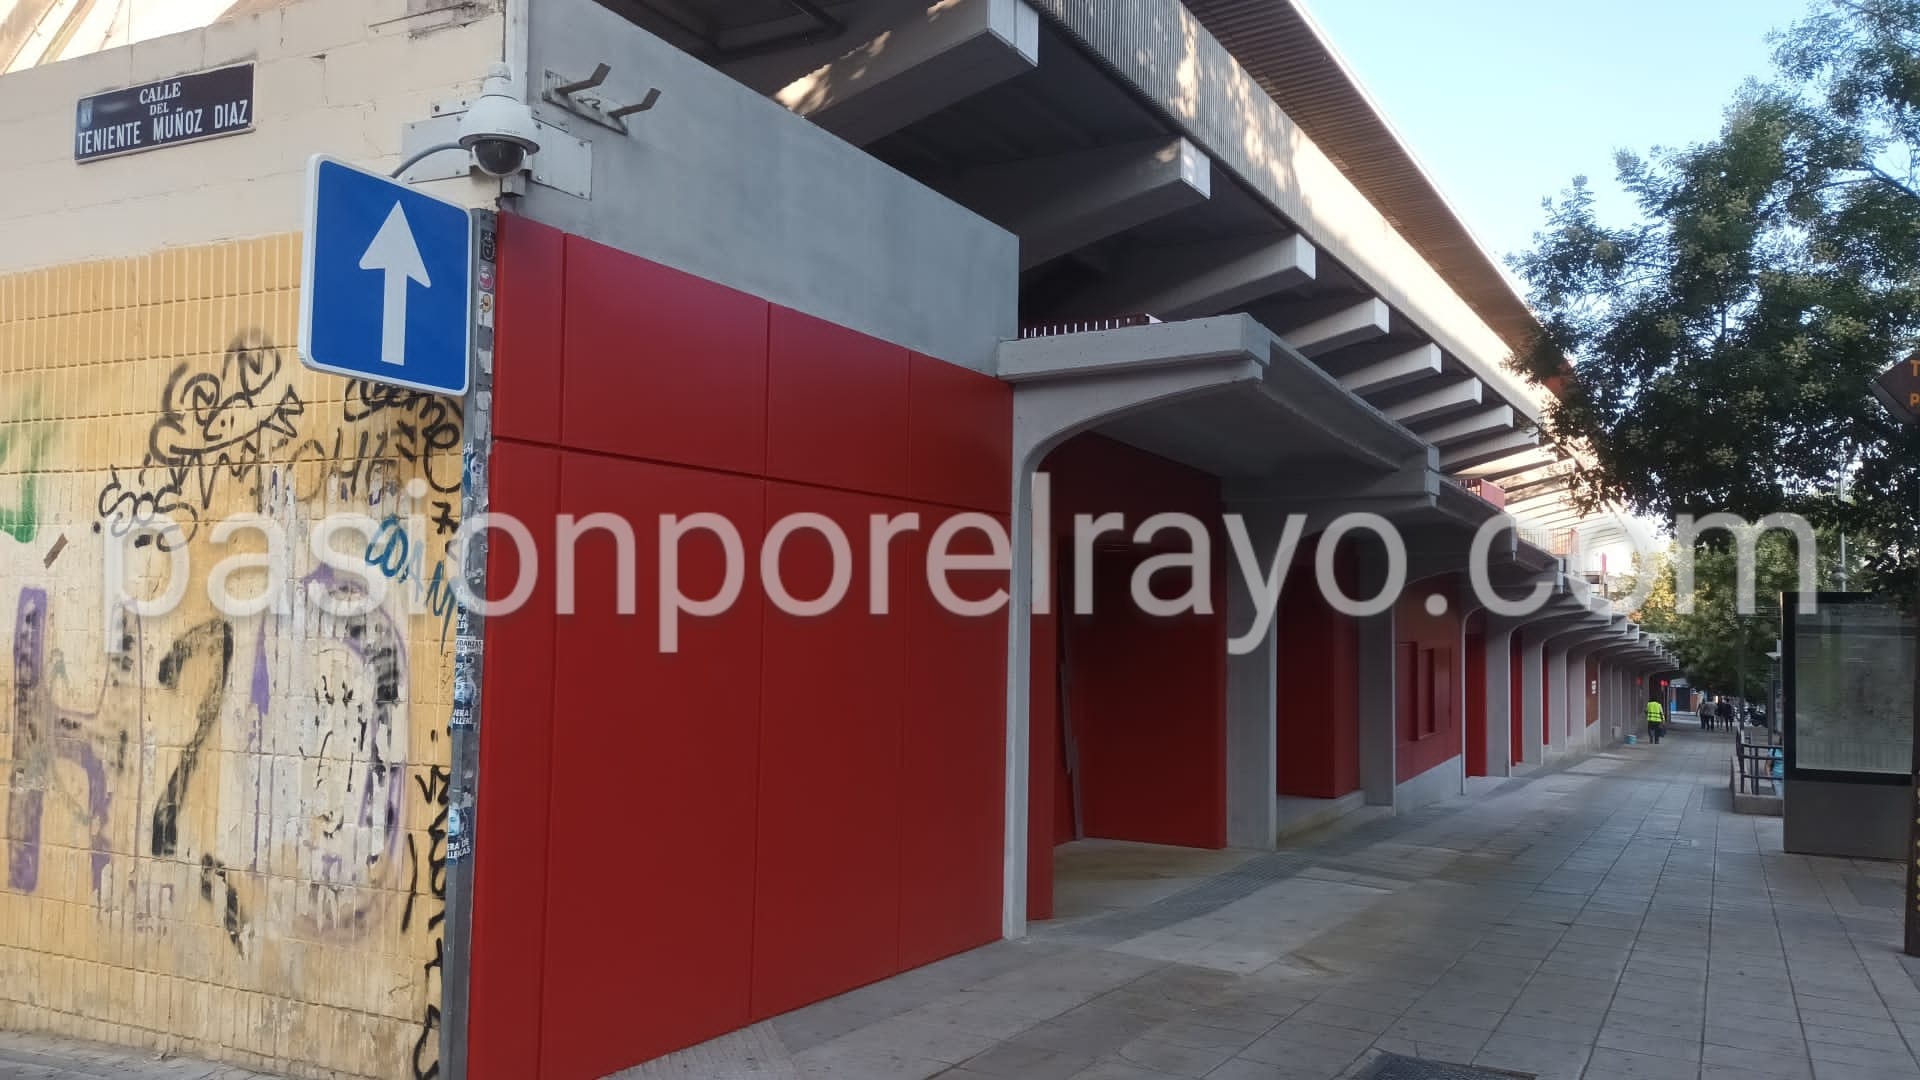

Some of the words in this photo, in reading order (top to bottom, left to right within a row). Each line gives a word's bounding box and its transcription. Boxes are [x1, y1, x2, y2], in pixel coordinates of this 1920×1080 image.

[139, 82, 182, 105] CALLE
[150, 102, 169, 116] DEL
[78, 121, 142, 155] TENIENTE
[153, 107, 203, 142] MUÑOZ
[214, 99, 248, 129] DIAZ
